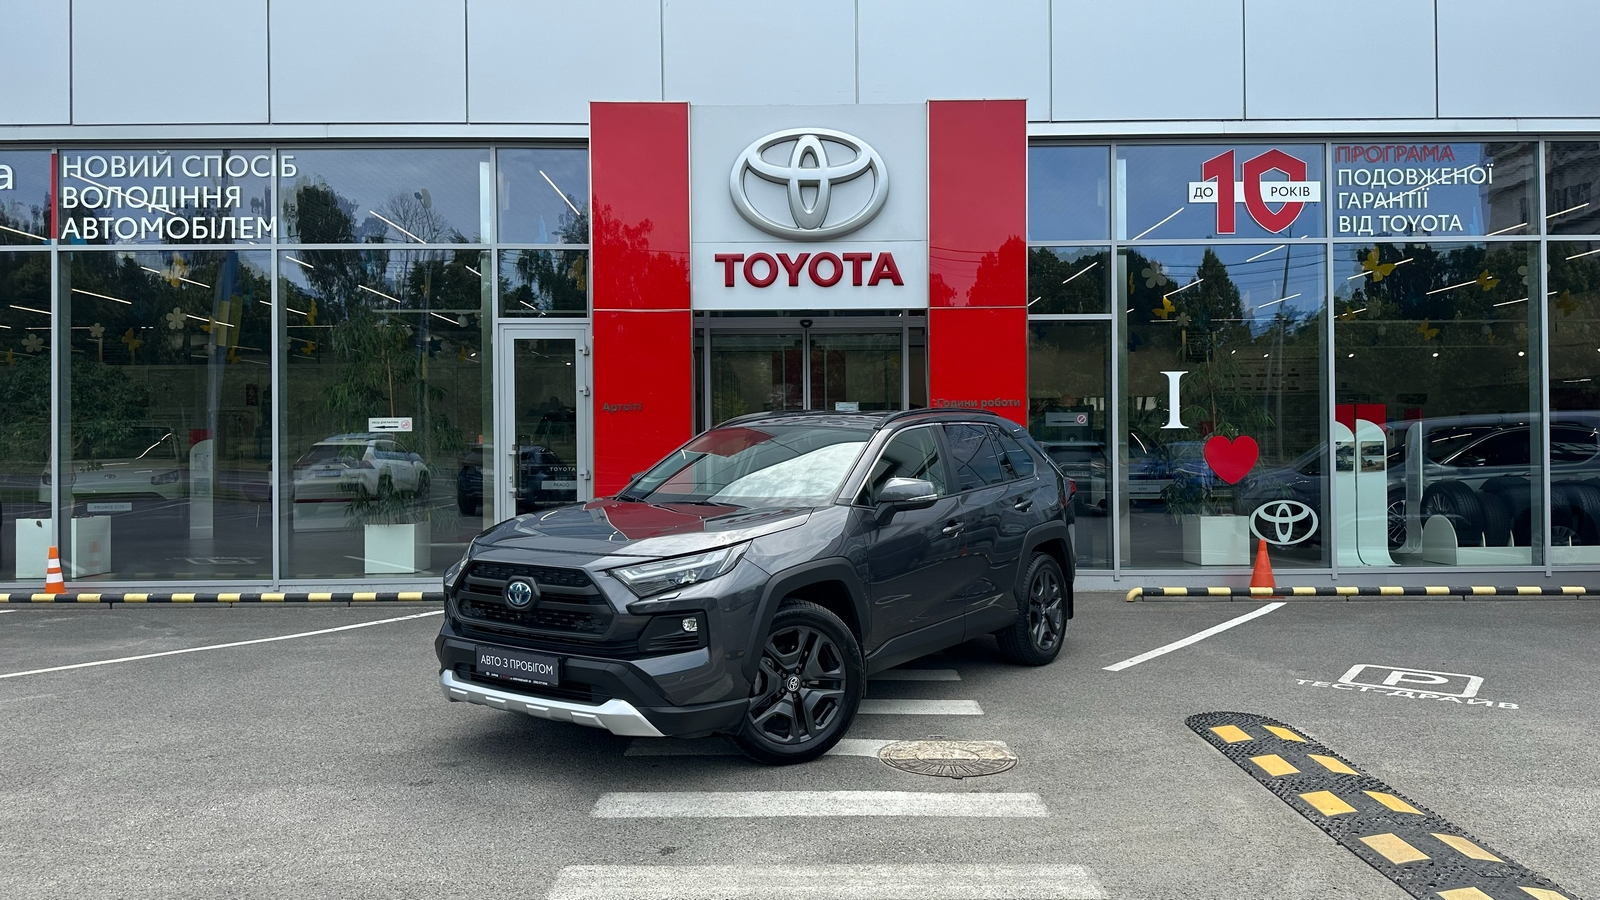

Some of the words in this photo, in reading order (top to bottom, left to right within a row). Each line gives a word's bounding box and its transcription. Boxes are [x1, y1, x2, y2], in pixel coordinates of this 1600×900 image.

[63, 150, 173, 178] НОВИЙ
[182, 154, 297, 178] СПОСІБ
[1336, 145, 1455, 162] ПРОГРАМА
[1338, 163, 1494, 189] ПОДОВЖЕНОЇ
[62, 186, 241, 212] ВОЛОДІННЯ
[1193, 187, 1214, 199] ДО
[1203, 148, 1307, 234] 10
[1271, 186, 1310, 197] РОКІВ
[1338, 187, 1430, 209] ГАРАНТІЇ
[61, 216, 277, 240] АВТОМОБІЛЕМ
[1339, 216, 1374, 236] ВІД
[1379, 215, 1463, 232] TOYOTA
[714, 252, 904, 288] TOYOTA
[602, 401, 643, 414] Артсіті
[937, 399, 977, 407] Години
[981, 398, 1020, 408] роботи
[1160, 371, 1189, 429] I
[480, 654, 501, 666] АВТО
[510, 659, 553, 675] ПРОБІГОМ
[1382, 670, 1449, 685] P
[1296, 679, 1519, 709] ТЕСТ-ДРАЙВ
